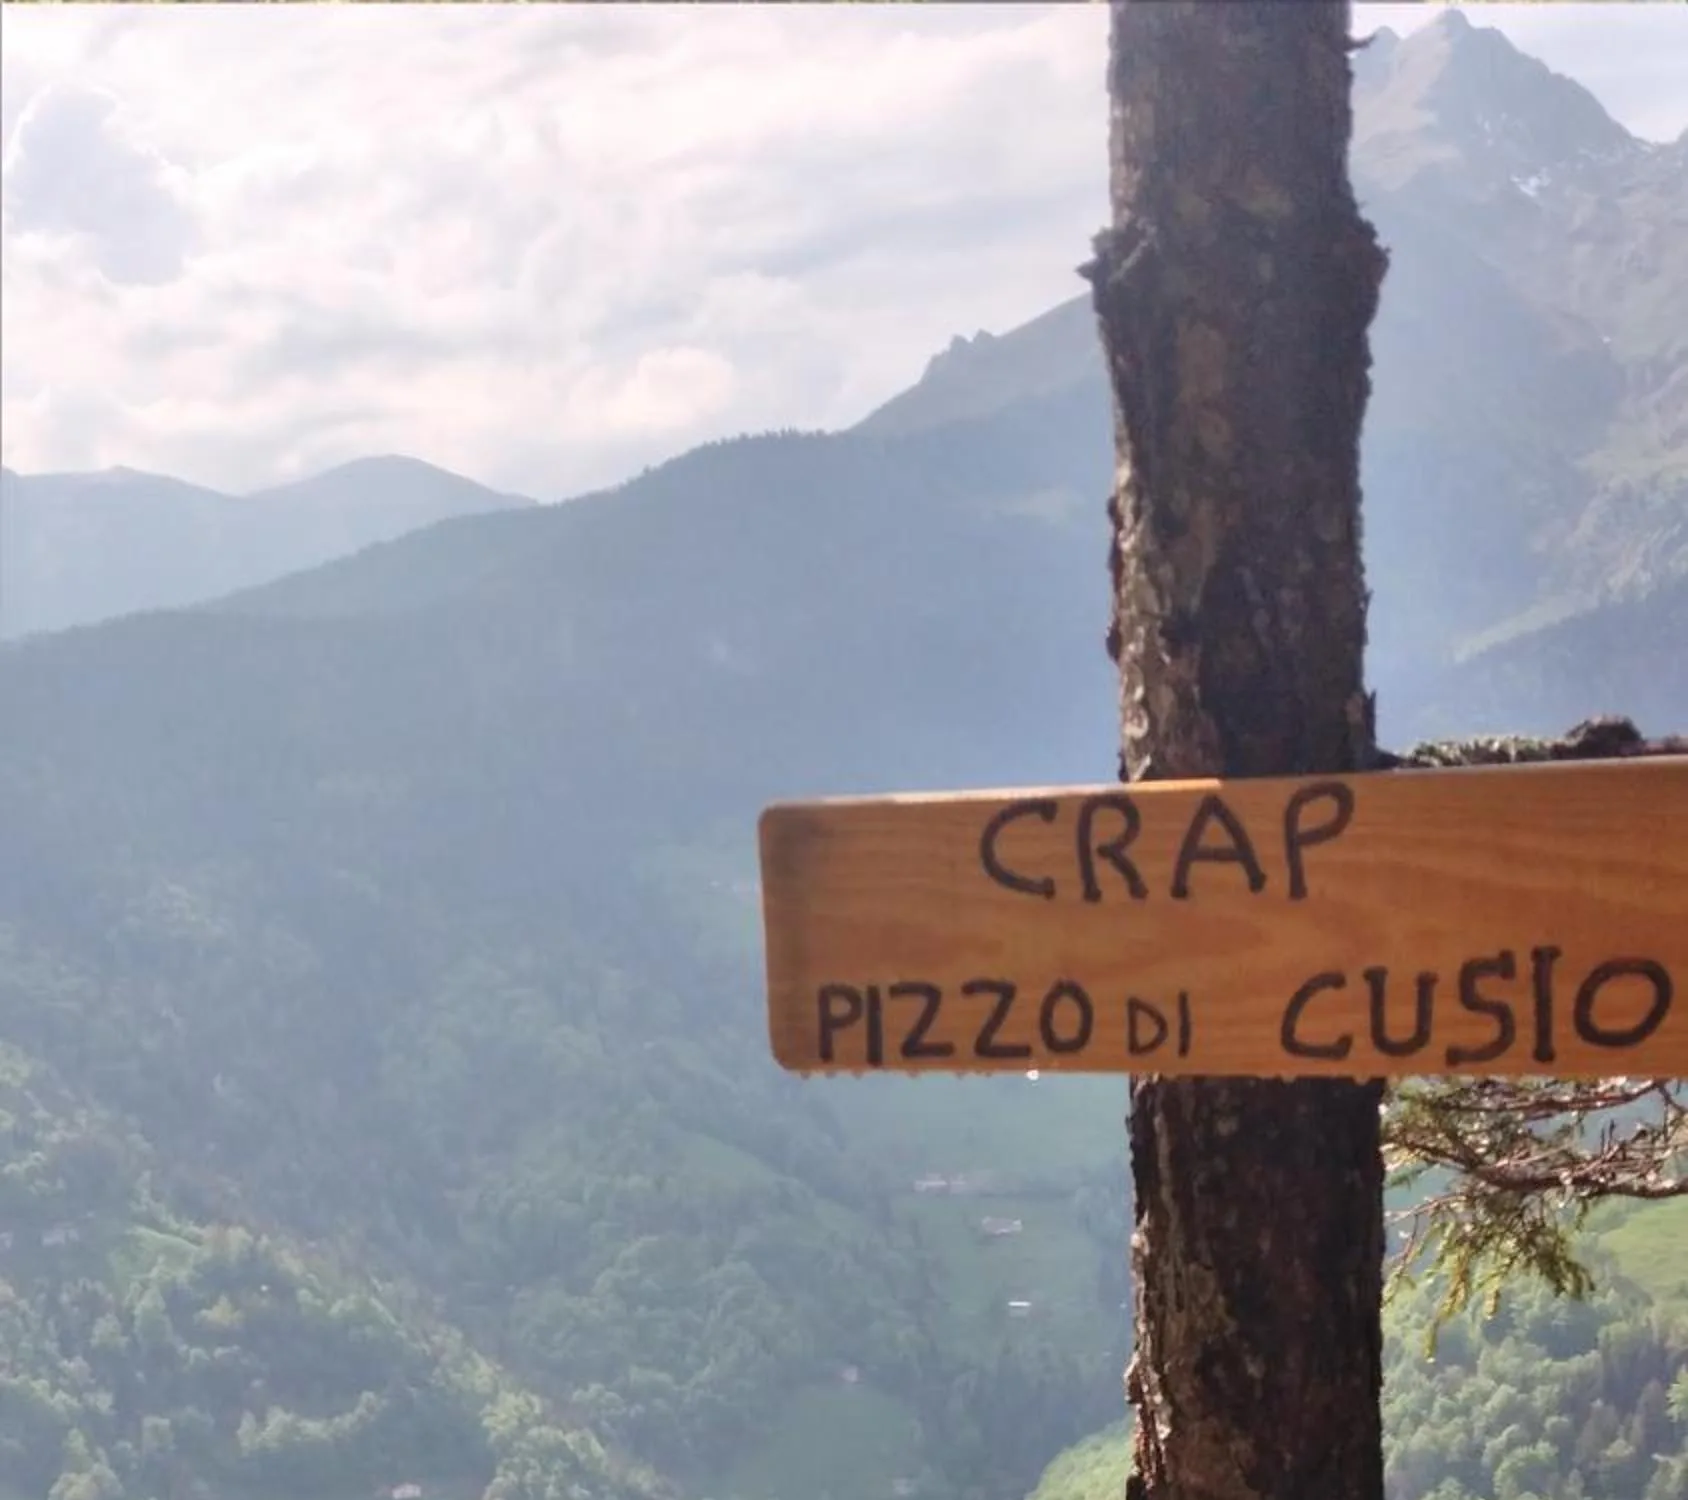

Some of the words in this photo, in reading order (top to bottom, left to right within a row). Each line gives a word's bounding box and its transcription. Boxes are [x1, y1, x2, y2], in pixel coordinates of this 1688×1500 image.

[978, 781, 1356, 904] CRAP
[816, 977, 1095, 1068] PIZZO
[1126, 990, 1193, 1060] DI
[1279, 944, 1676, 1068] CUSIO
